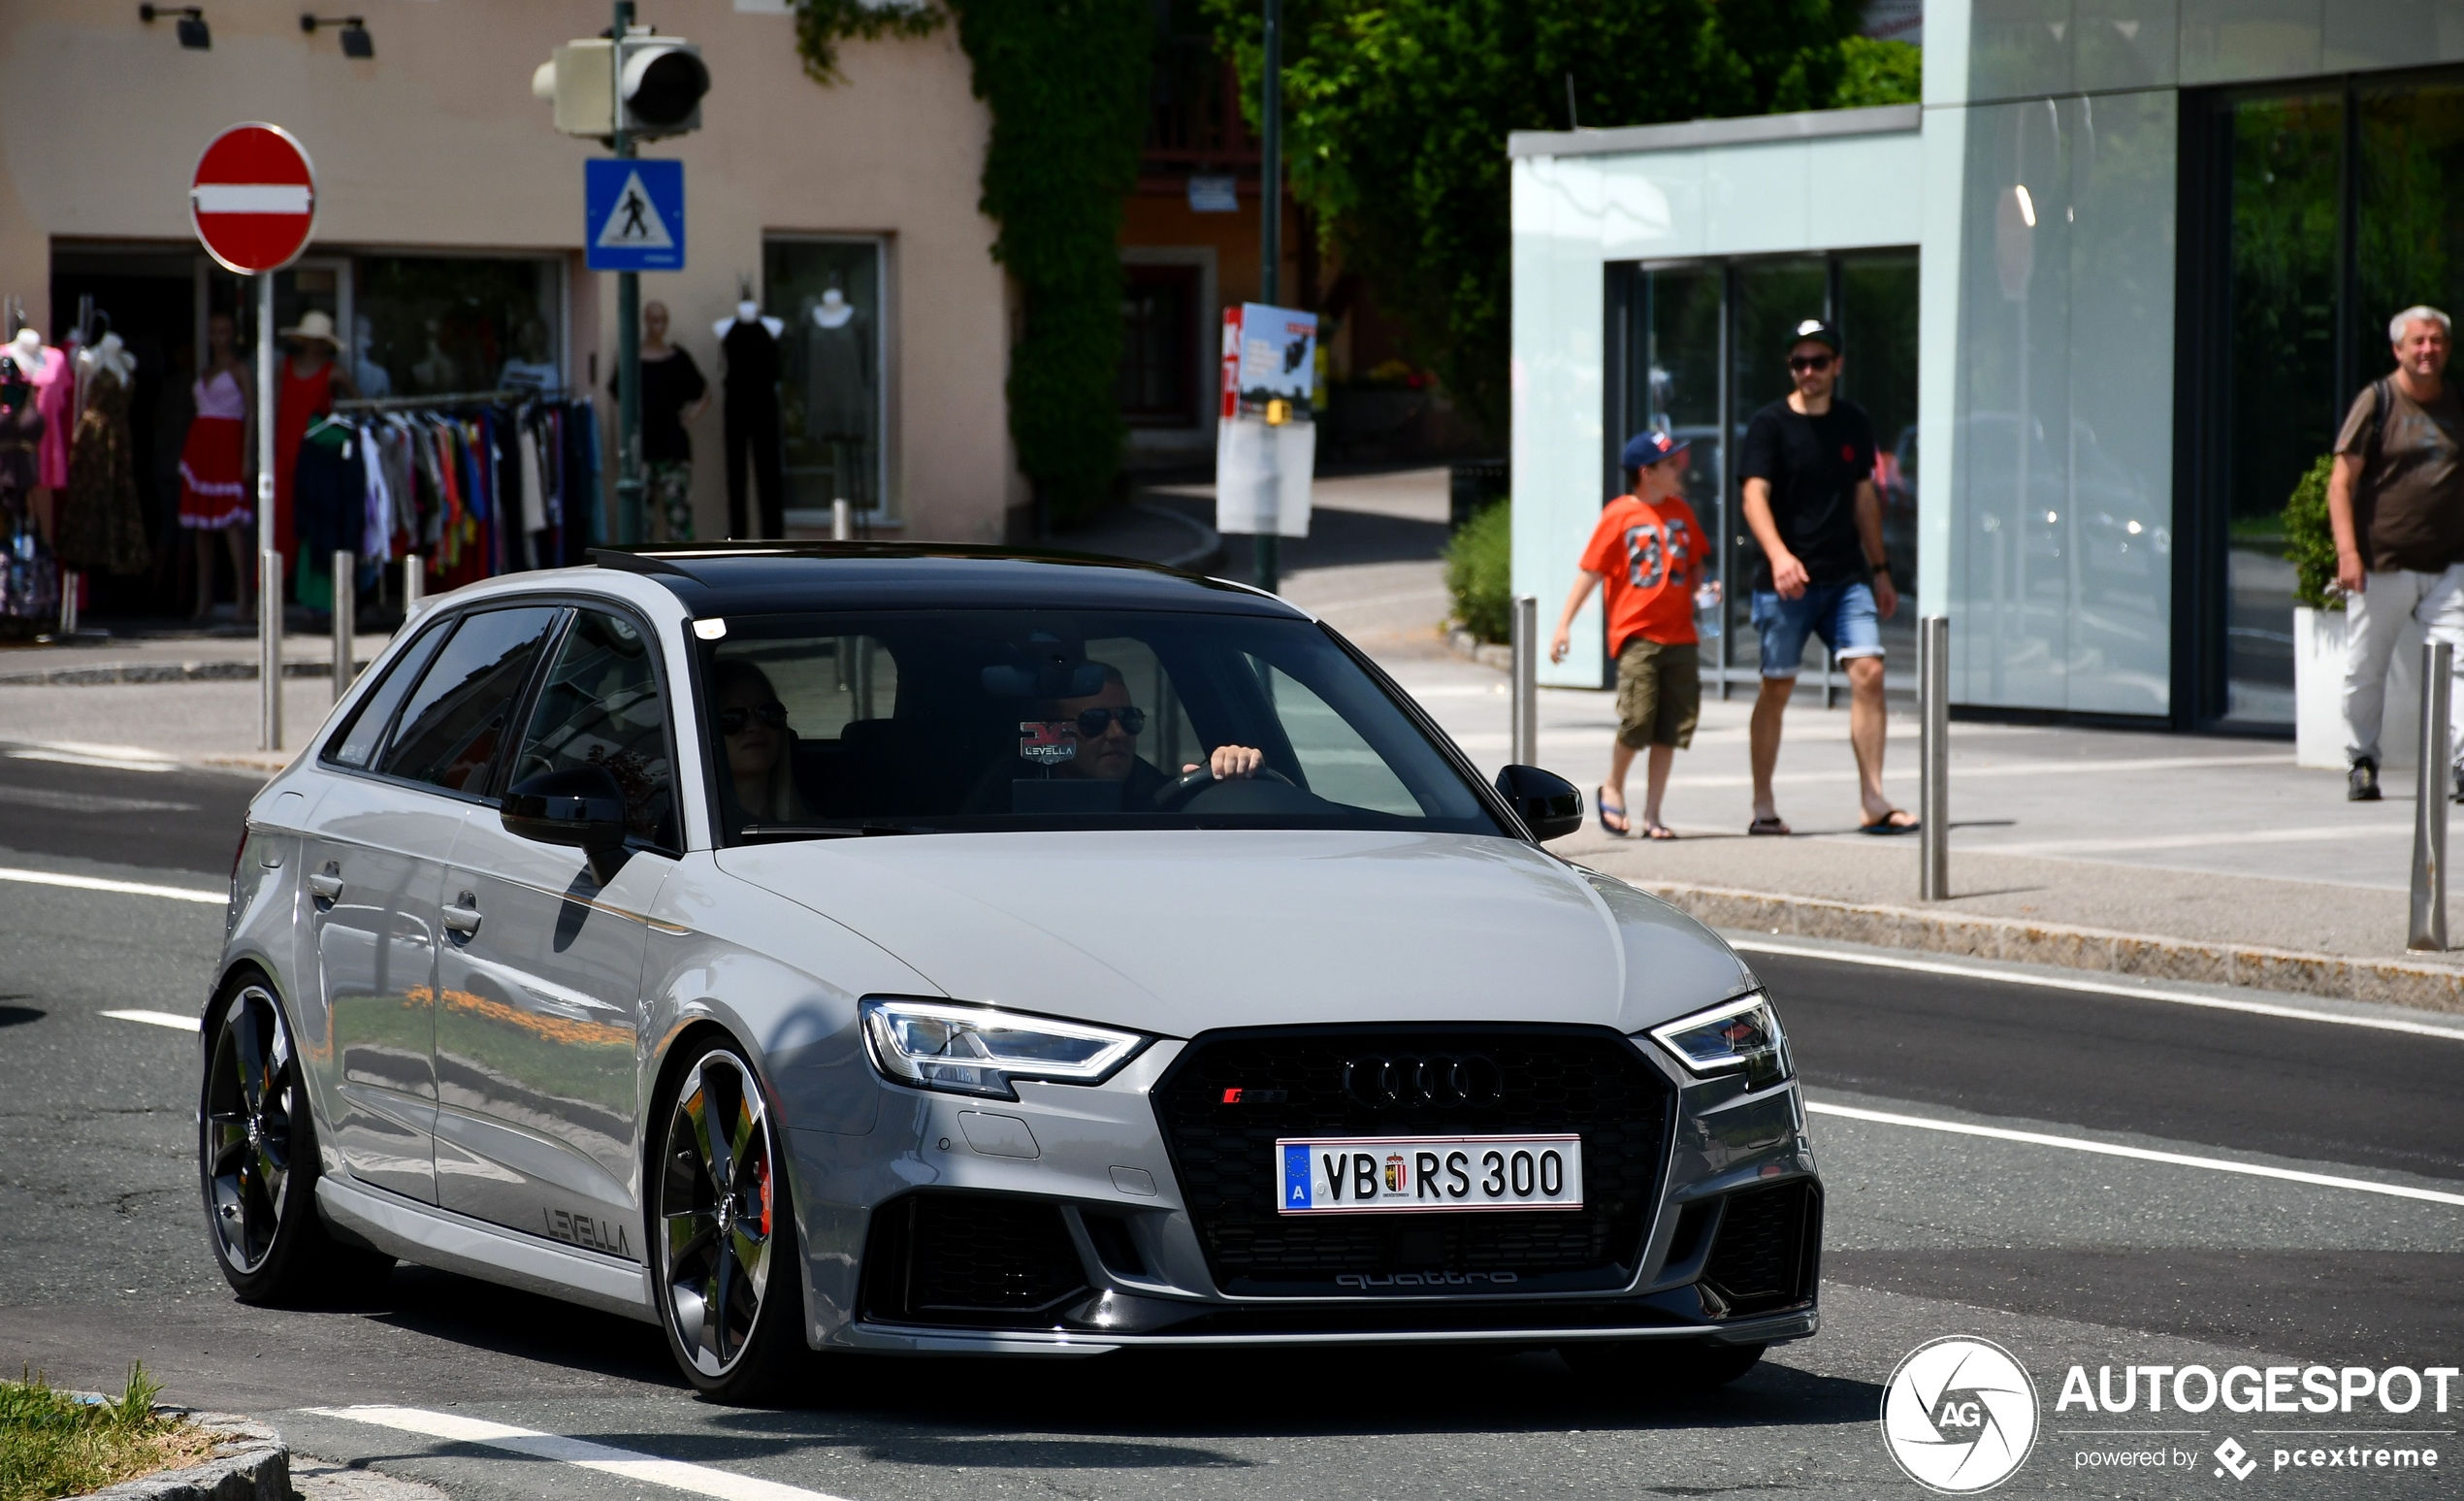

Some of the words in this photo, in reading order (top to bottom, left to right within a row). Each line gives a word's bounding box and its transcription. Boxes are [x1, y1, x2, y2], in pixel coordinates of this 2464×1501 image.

[1322, 1153, 1378, 1200] VB
[1415, 1151, 1470, 1198] RS
[1481, 1149, 1563, 1197] 300
[1292, 1186, 1305, 1200] A
[543, 1207, 631, 1256] LEVELLA
[1336, 1270, 1518, 1289] quattro
